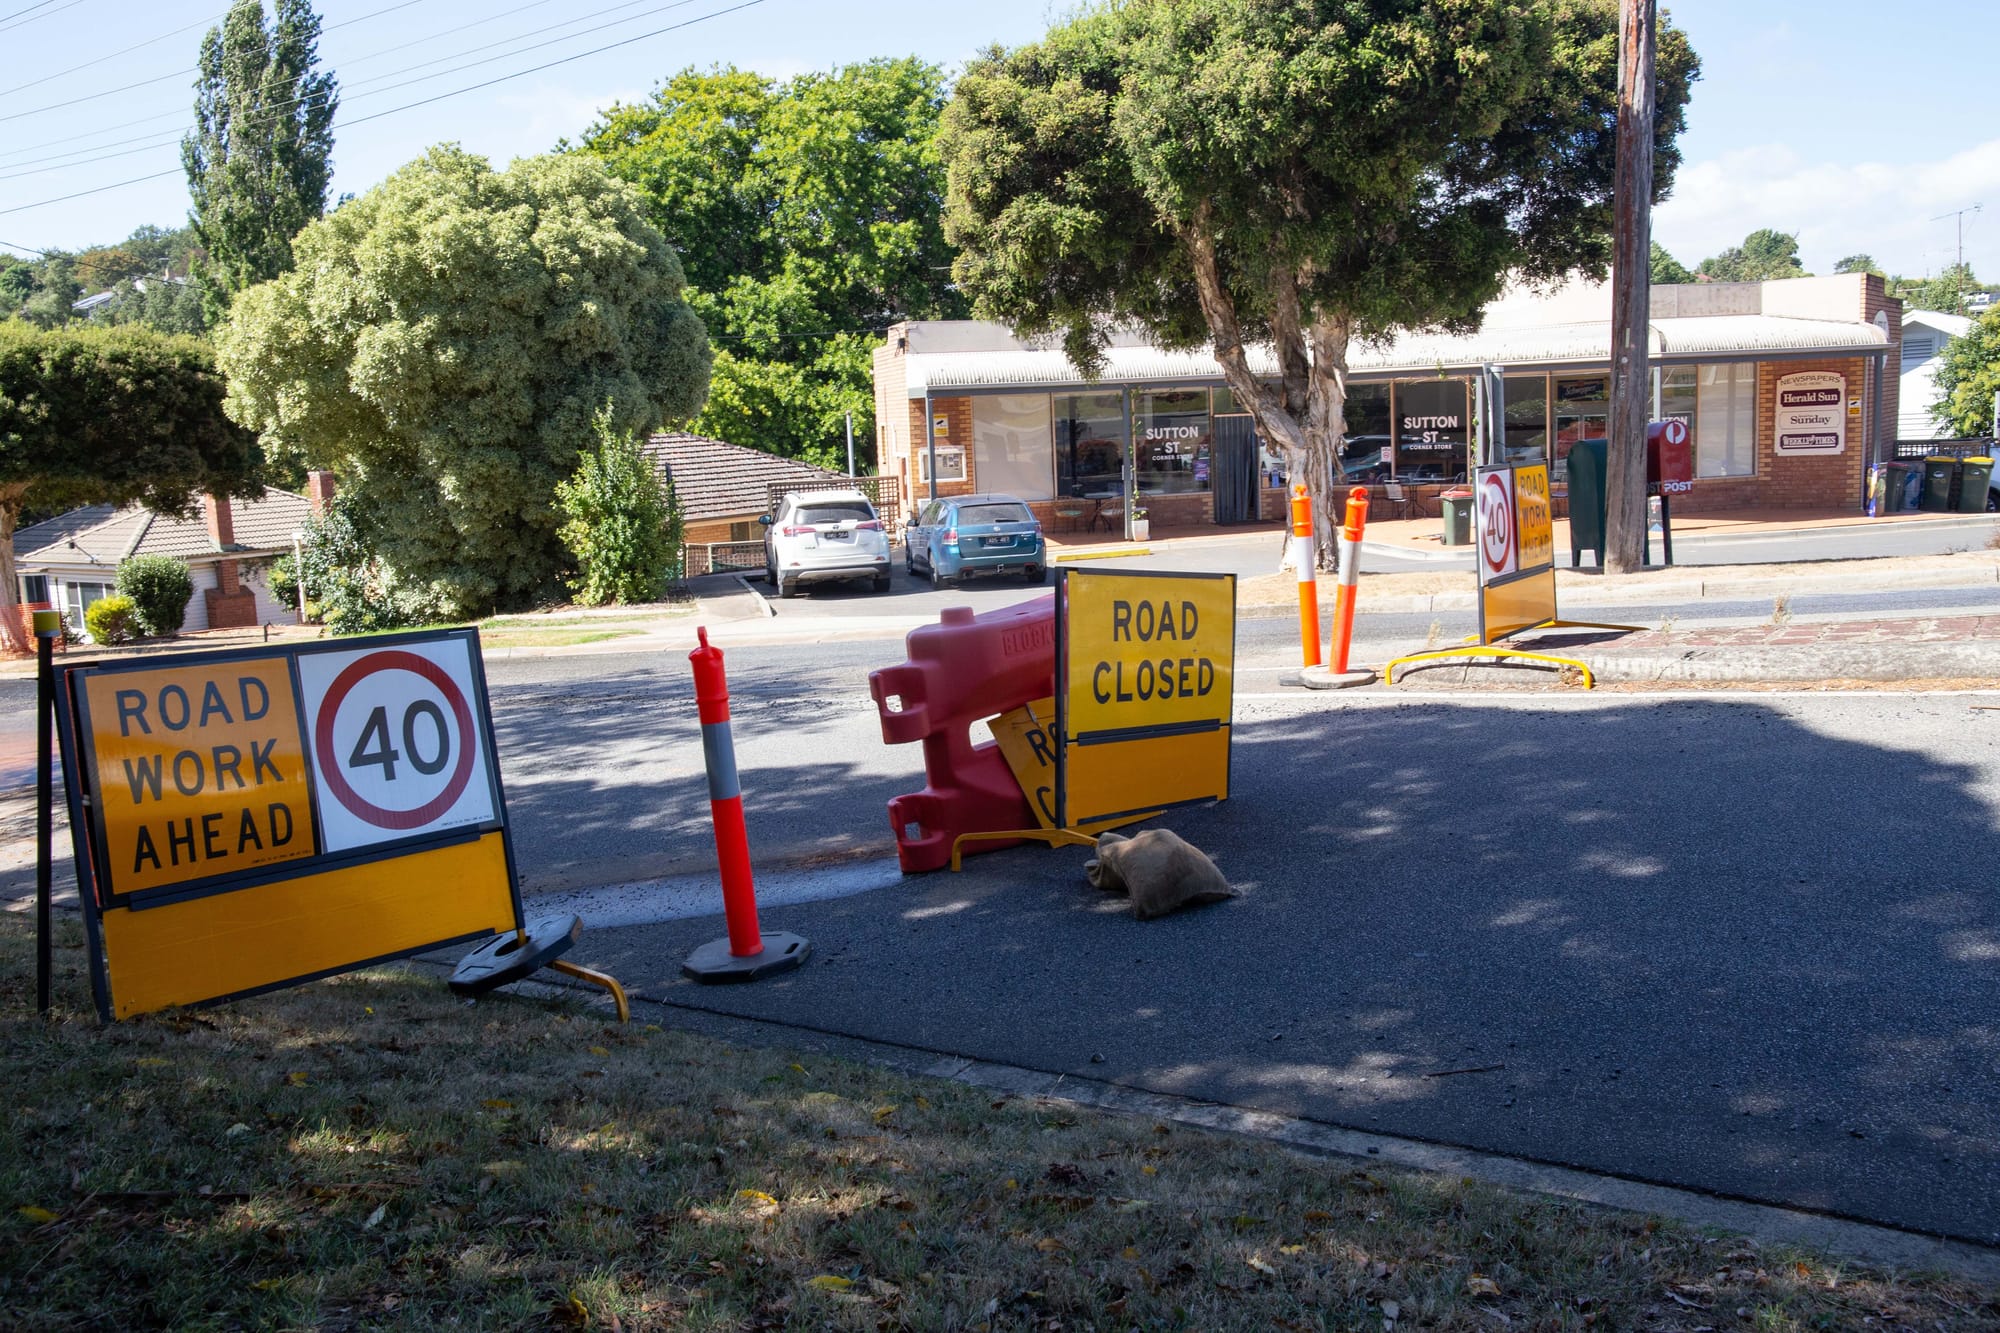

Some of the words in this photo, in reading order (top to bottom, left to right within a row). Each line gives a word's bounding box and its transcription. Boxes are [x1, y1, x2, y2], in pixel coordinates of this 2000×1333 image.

[1780, 375, 1841, 385] NEWSPAPERS
[1783, 392, 1817, 403] Herald
[1817, 391, 1838, 401] Sun
[1403, 415, 1458, 429] SUTTON
[1790, 414, 1831, 425] Sunday
[1145, 426, 1199, 440] SUTTON
[1422, 431, 1439, 443] ST
[1164, 441, 1180, 453] ST
[1519, 472, 1545, 497] ROAD
[1663, 480, 1694, 493] POST
[1487, 501, 1507, 546] 40
[1521, 502, 1549, 529] WORK
[1113, 599, 1199, 642] ROAD
[1092, 657, 1215, 705] CLOSED
[115, 676, 270, 737] ROAD
[348, 699, 450, 782] 40
[123, 738, 284, 805] WORK
[133, 802, 294, 873] AHEAD
